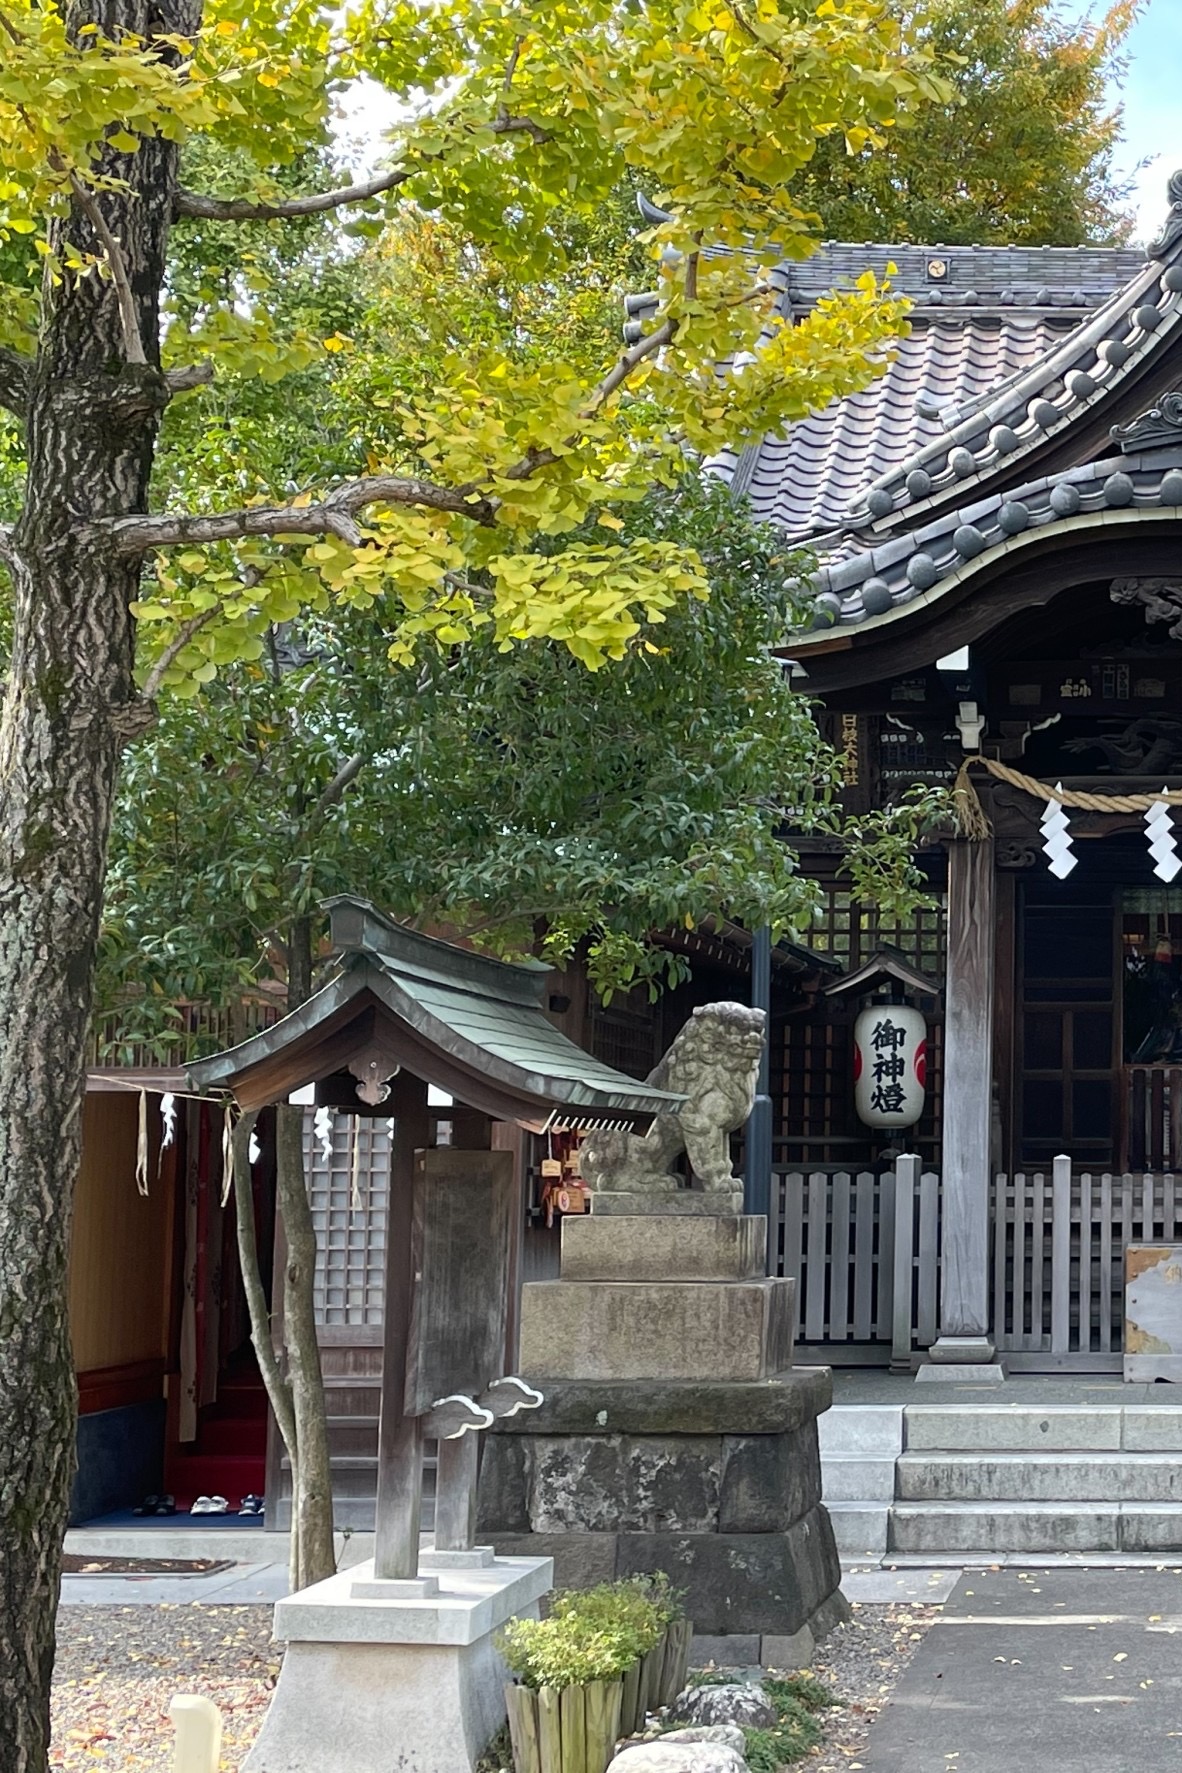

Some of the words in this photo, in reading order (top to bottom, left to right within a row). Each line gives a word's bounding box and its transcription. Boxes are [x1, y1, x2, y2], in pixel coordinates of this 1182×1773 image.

[841, 713, 859, 786] 日枝大神社
[870, 1018, 908, 1113] 御神燈
